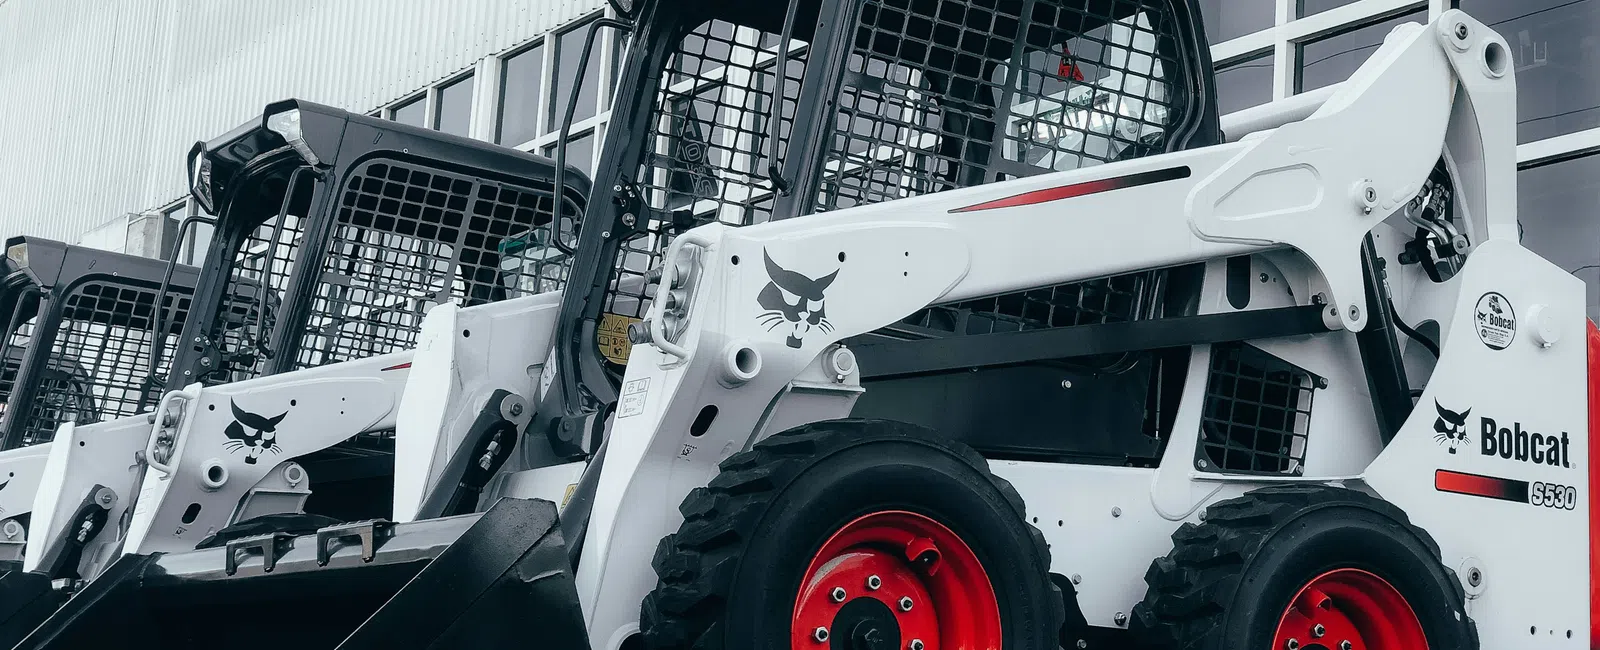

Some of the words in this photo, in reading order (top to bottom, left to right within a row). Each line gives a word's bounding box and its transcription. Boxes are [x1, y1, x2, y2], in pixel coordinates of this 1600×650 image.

[1489, 313, 1515, 331] Bobcat
[1480, 416, 1570, 469] Bobcat
[1531, 481, 1577, 511] S530
